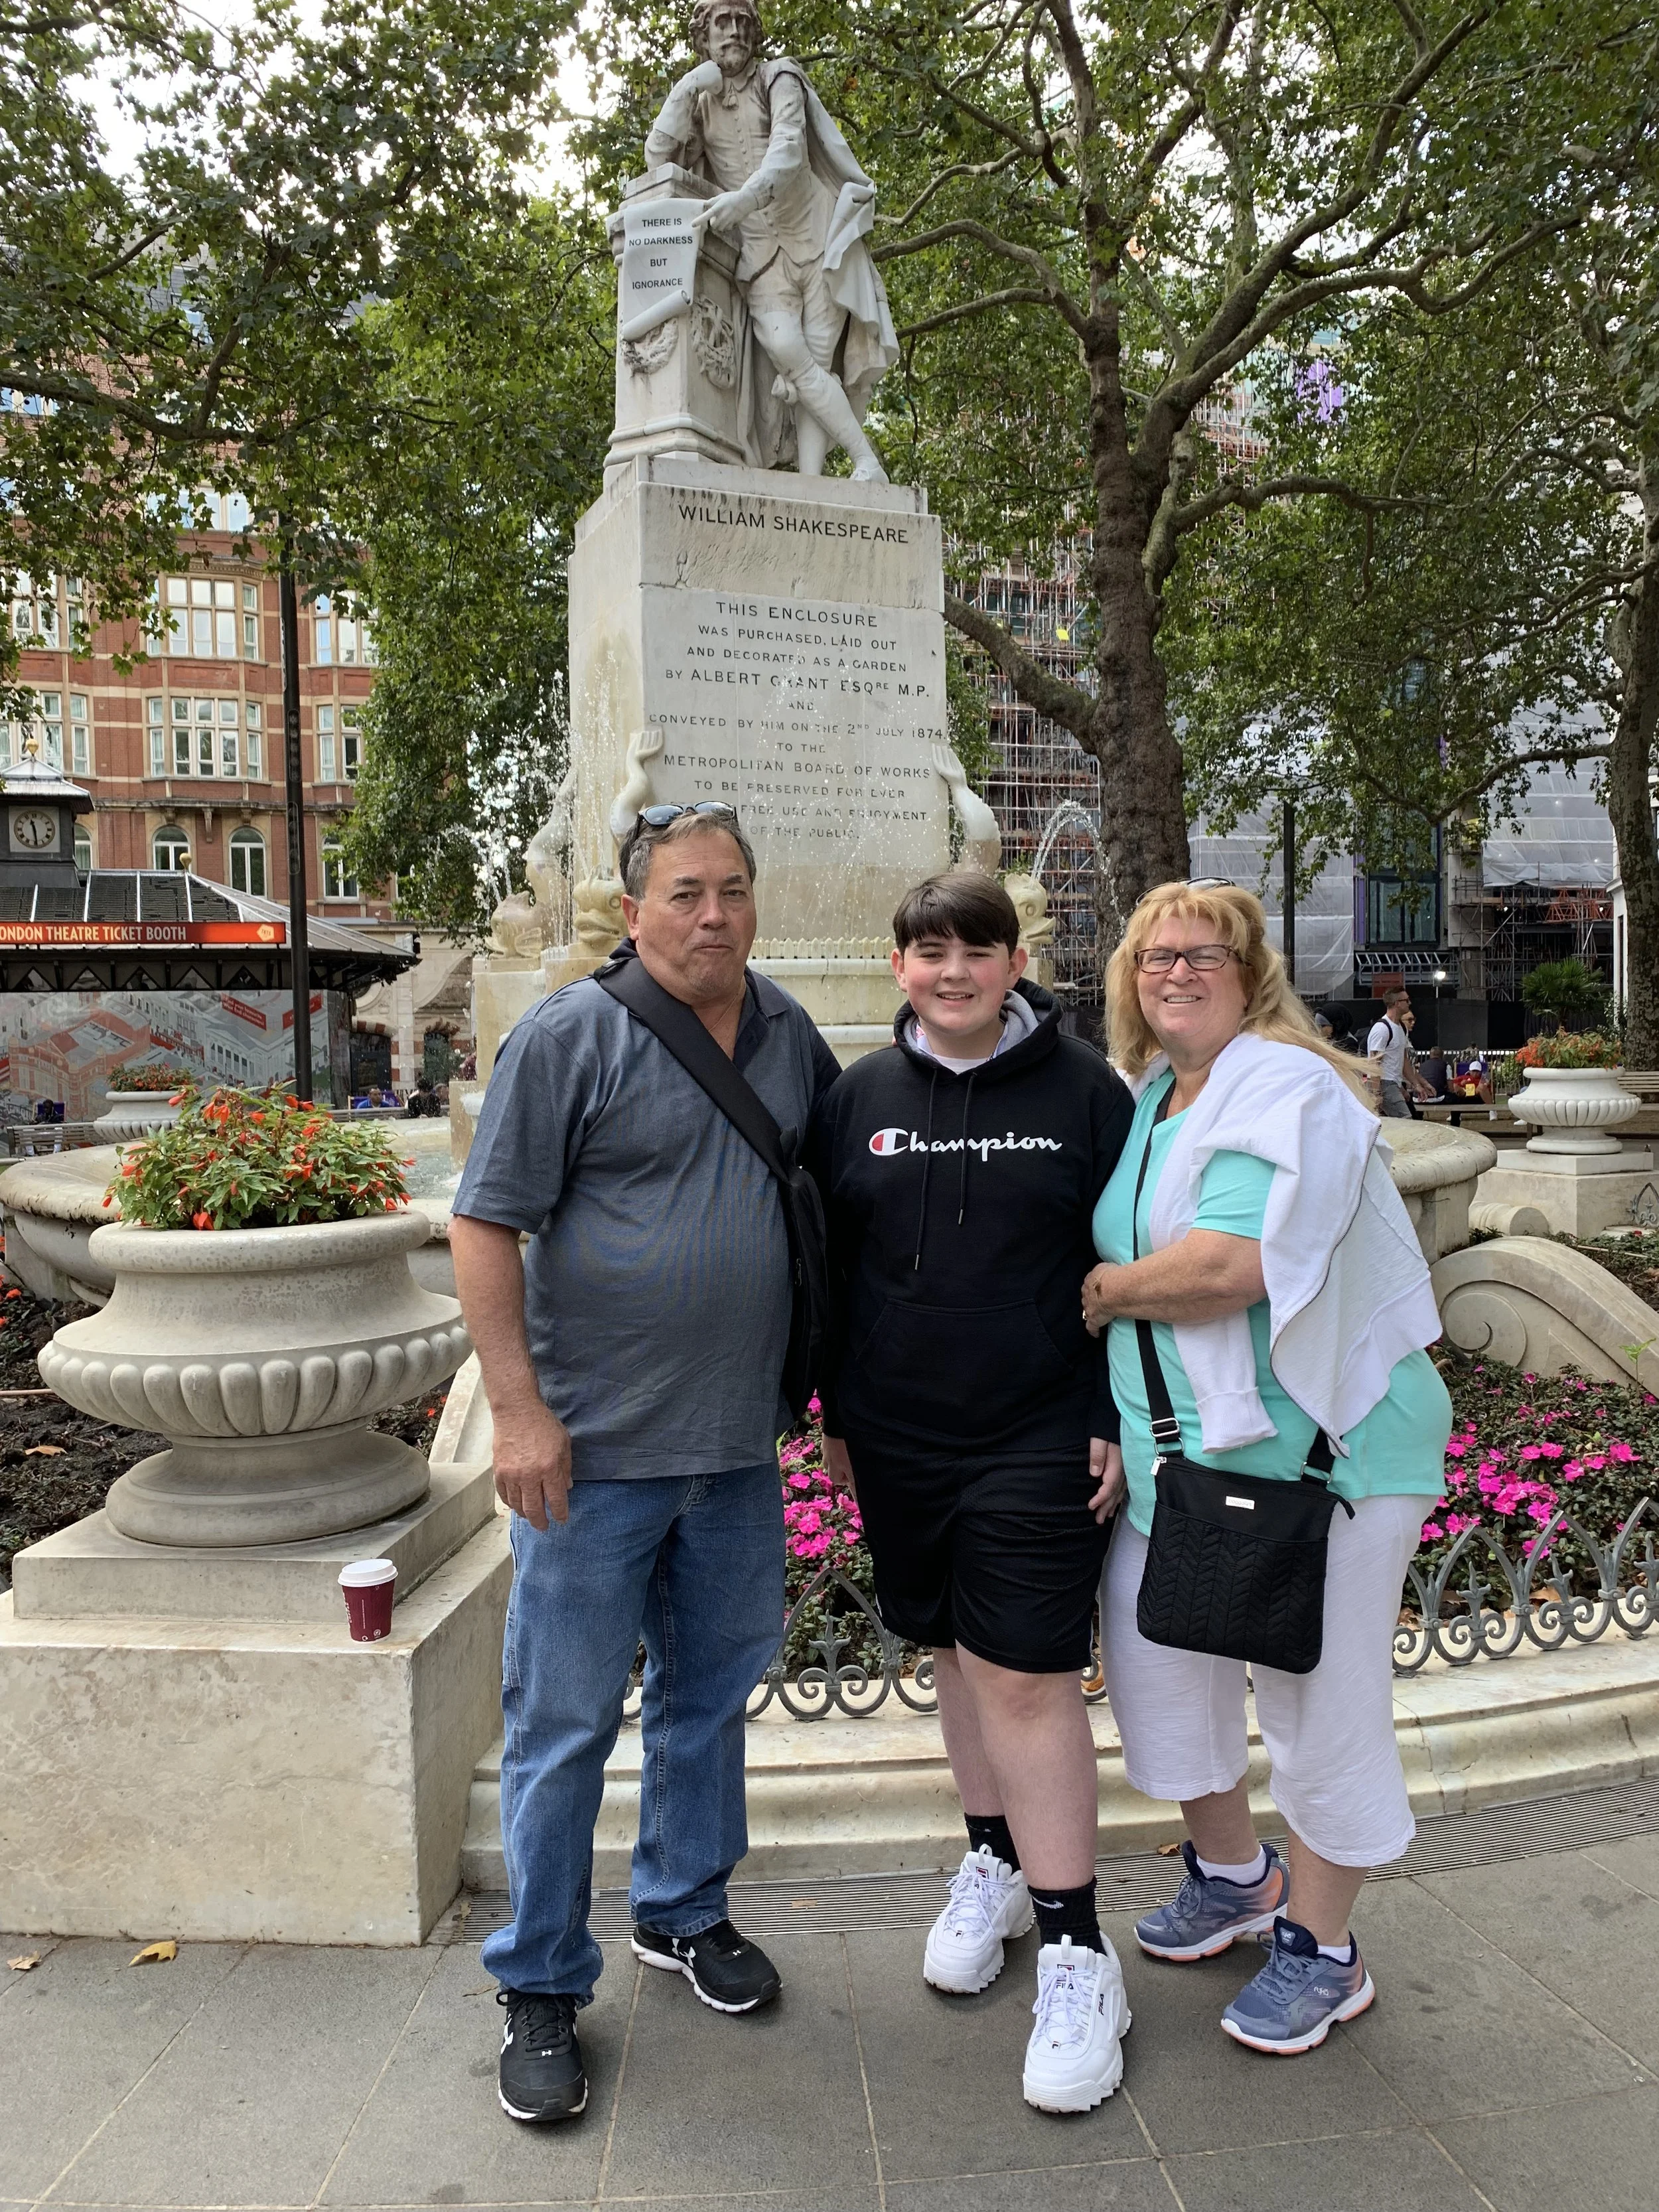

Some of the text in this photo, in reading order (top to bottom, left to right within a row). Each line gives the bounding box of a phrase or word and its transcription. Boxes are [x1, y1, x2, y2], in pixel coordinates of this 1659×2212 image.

[642, 218, 672, 228] THERE
[629, 236, 693, 247] NO DARKNESS
[650, 258, 668, 267] BUT
[632, 278, 684, 290] IGNORANCE
[678, 504, 909, 544] WILLIAM SHAKESPEARE
[715, 601, 878, 628] THIS ENCLOSURE
[697, 625, 897, 650] WAS PURCHASED, LAID OUT
[687, 646, 906, 672] AND DECORATED AS A GARDEN
[666, 669, 683, 680] BY
[691, 668, 761, 686] ALBERT
[898, 684, 930, 698] M.P.
[788, 700, 814, 711] AND
[649, 714, 727, 727] CONVEYED
[738, 719, 754, 729] BY
[760, 721, 784, 731] HIM
[791, 722, 808, 732] ON
[814, 723, 839, 734] THE
[875, 727, 904, 737] JULY
[912, 727, 947, 740] 1874.
[776, 742, 826, 753] TO THE
[664, 755, 930, 779] METROPOLITAN BOARD OF WORKS
[694, 780, 905, 798] TO BE PRESERVED FOR EVER
[741, 804, 774, 815] FREE
[782, 806, 808, 817] USE
[750, 826, 767, 836] OF
[774, 827, 800, 837] THE
[45, 925, 100, 941] THEATRE
[103, 925, 143, 941] TICKET
[146, 925, 186, 941] BOOTH
[868, 1128, 1063, 1162] Champion
[1056, 1979, 1074, 1990] FIA
